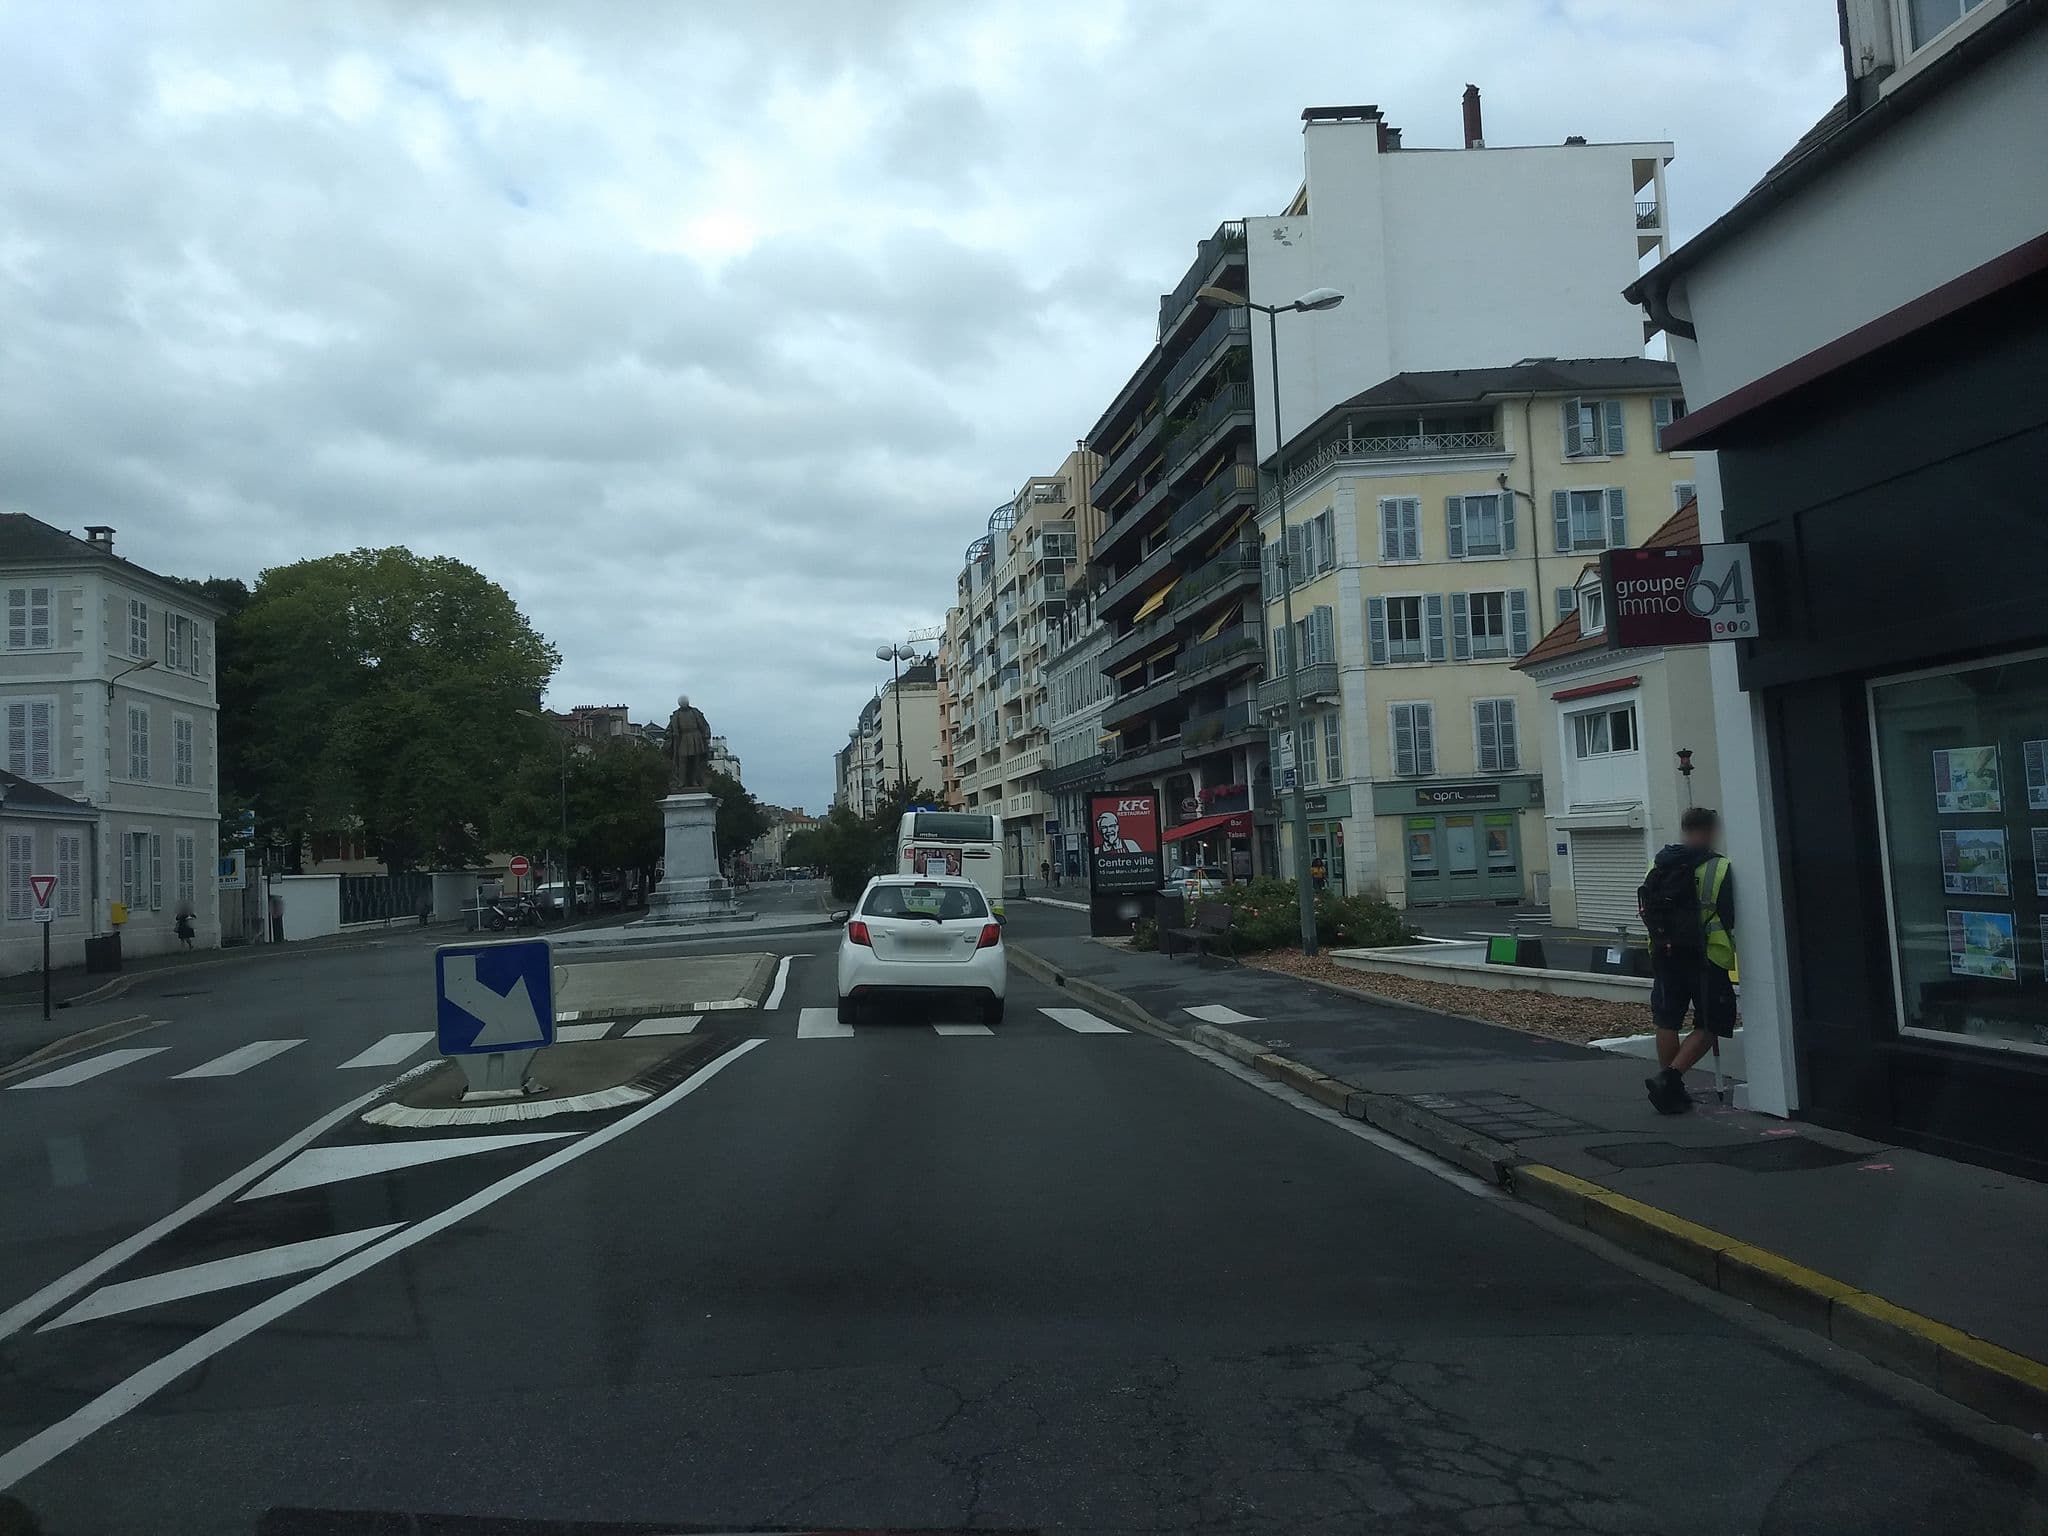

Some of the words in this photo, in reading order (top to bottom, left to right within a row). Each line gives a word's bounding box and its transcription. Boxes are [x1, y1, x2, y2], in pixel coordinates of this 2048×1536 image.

[1616, 577, 1686, 599] groupe
[1618, 596, 1682, 616] immo
[1684, 560, 1751, 618] 64
[1433, 791, 1465, 802] april
[1117, 799, 1150, 811] KFC
[1098, 858, 1132, 868] Centre
[1133, 856, 1154, 866] ville
